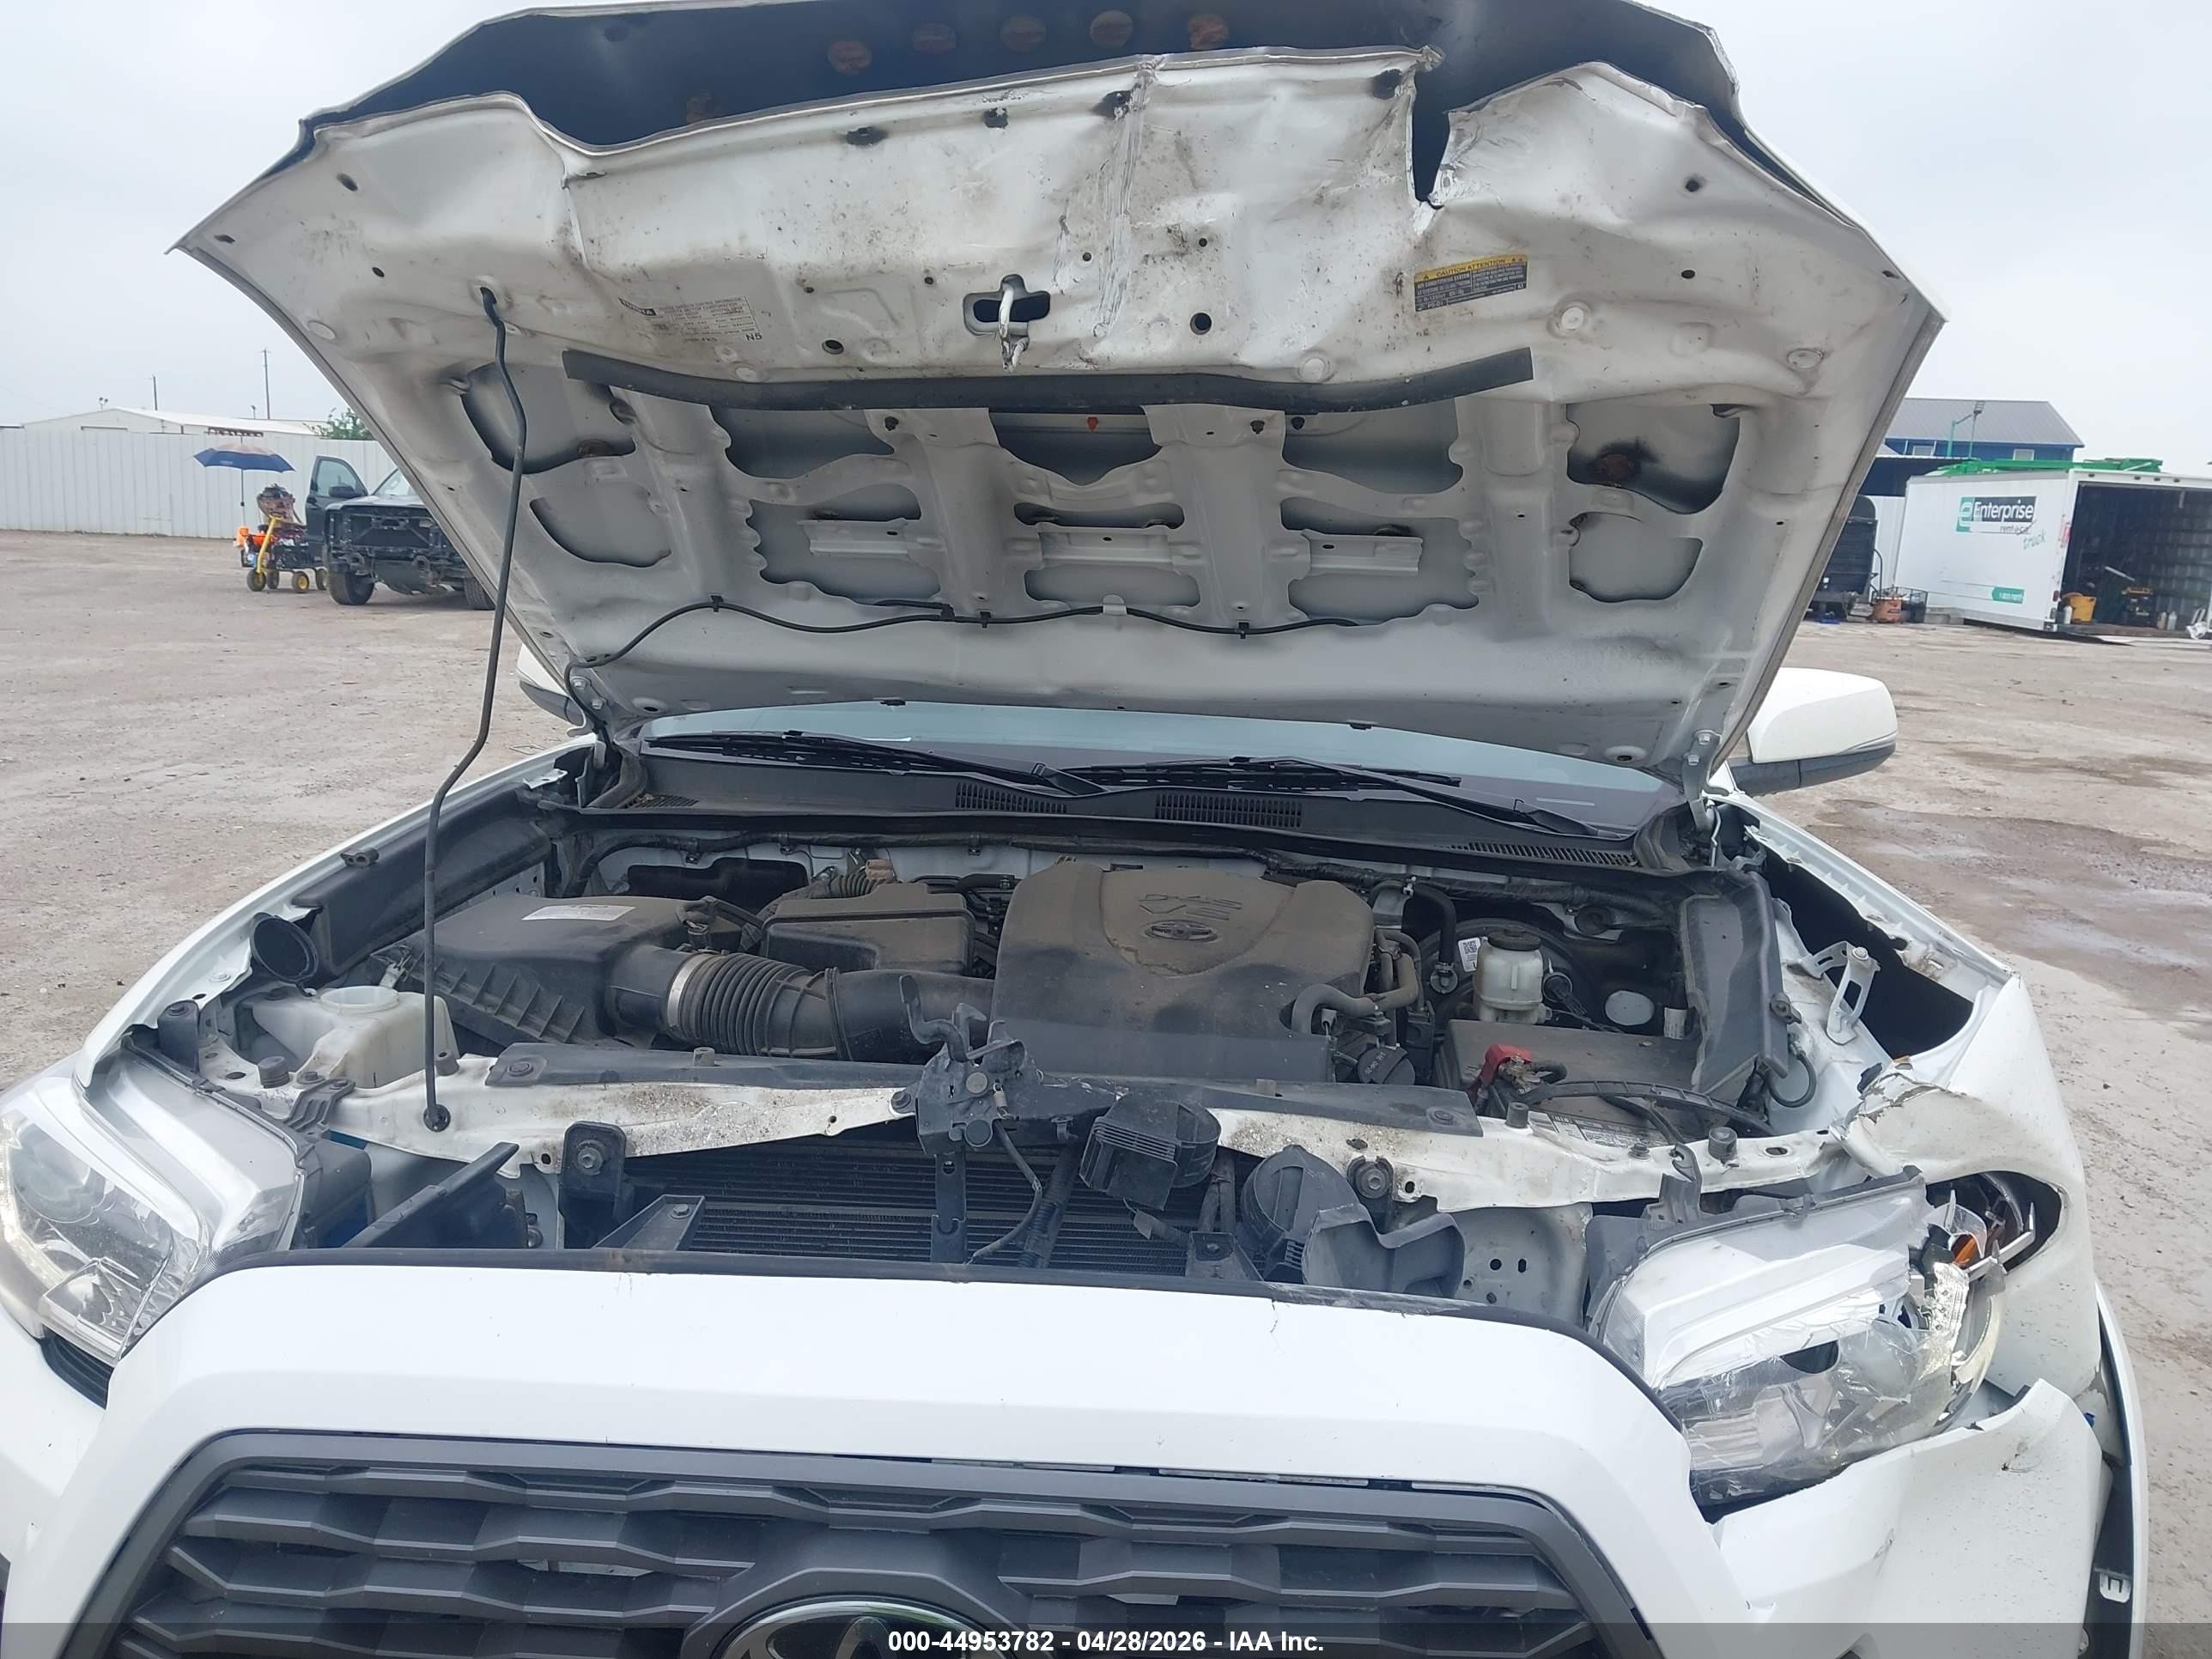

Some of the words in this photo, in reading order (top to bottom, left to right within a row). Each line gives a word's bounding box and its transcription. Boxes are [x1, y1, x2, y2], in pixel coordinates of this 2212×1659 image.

[1436, 267, 1467, 277] CAUTION
[745, 332, 763, 342] N5
[1973, 499, 2034, 522] Enterprise
